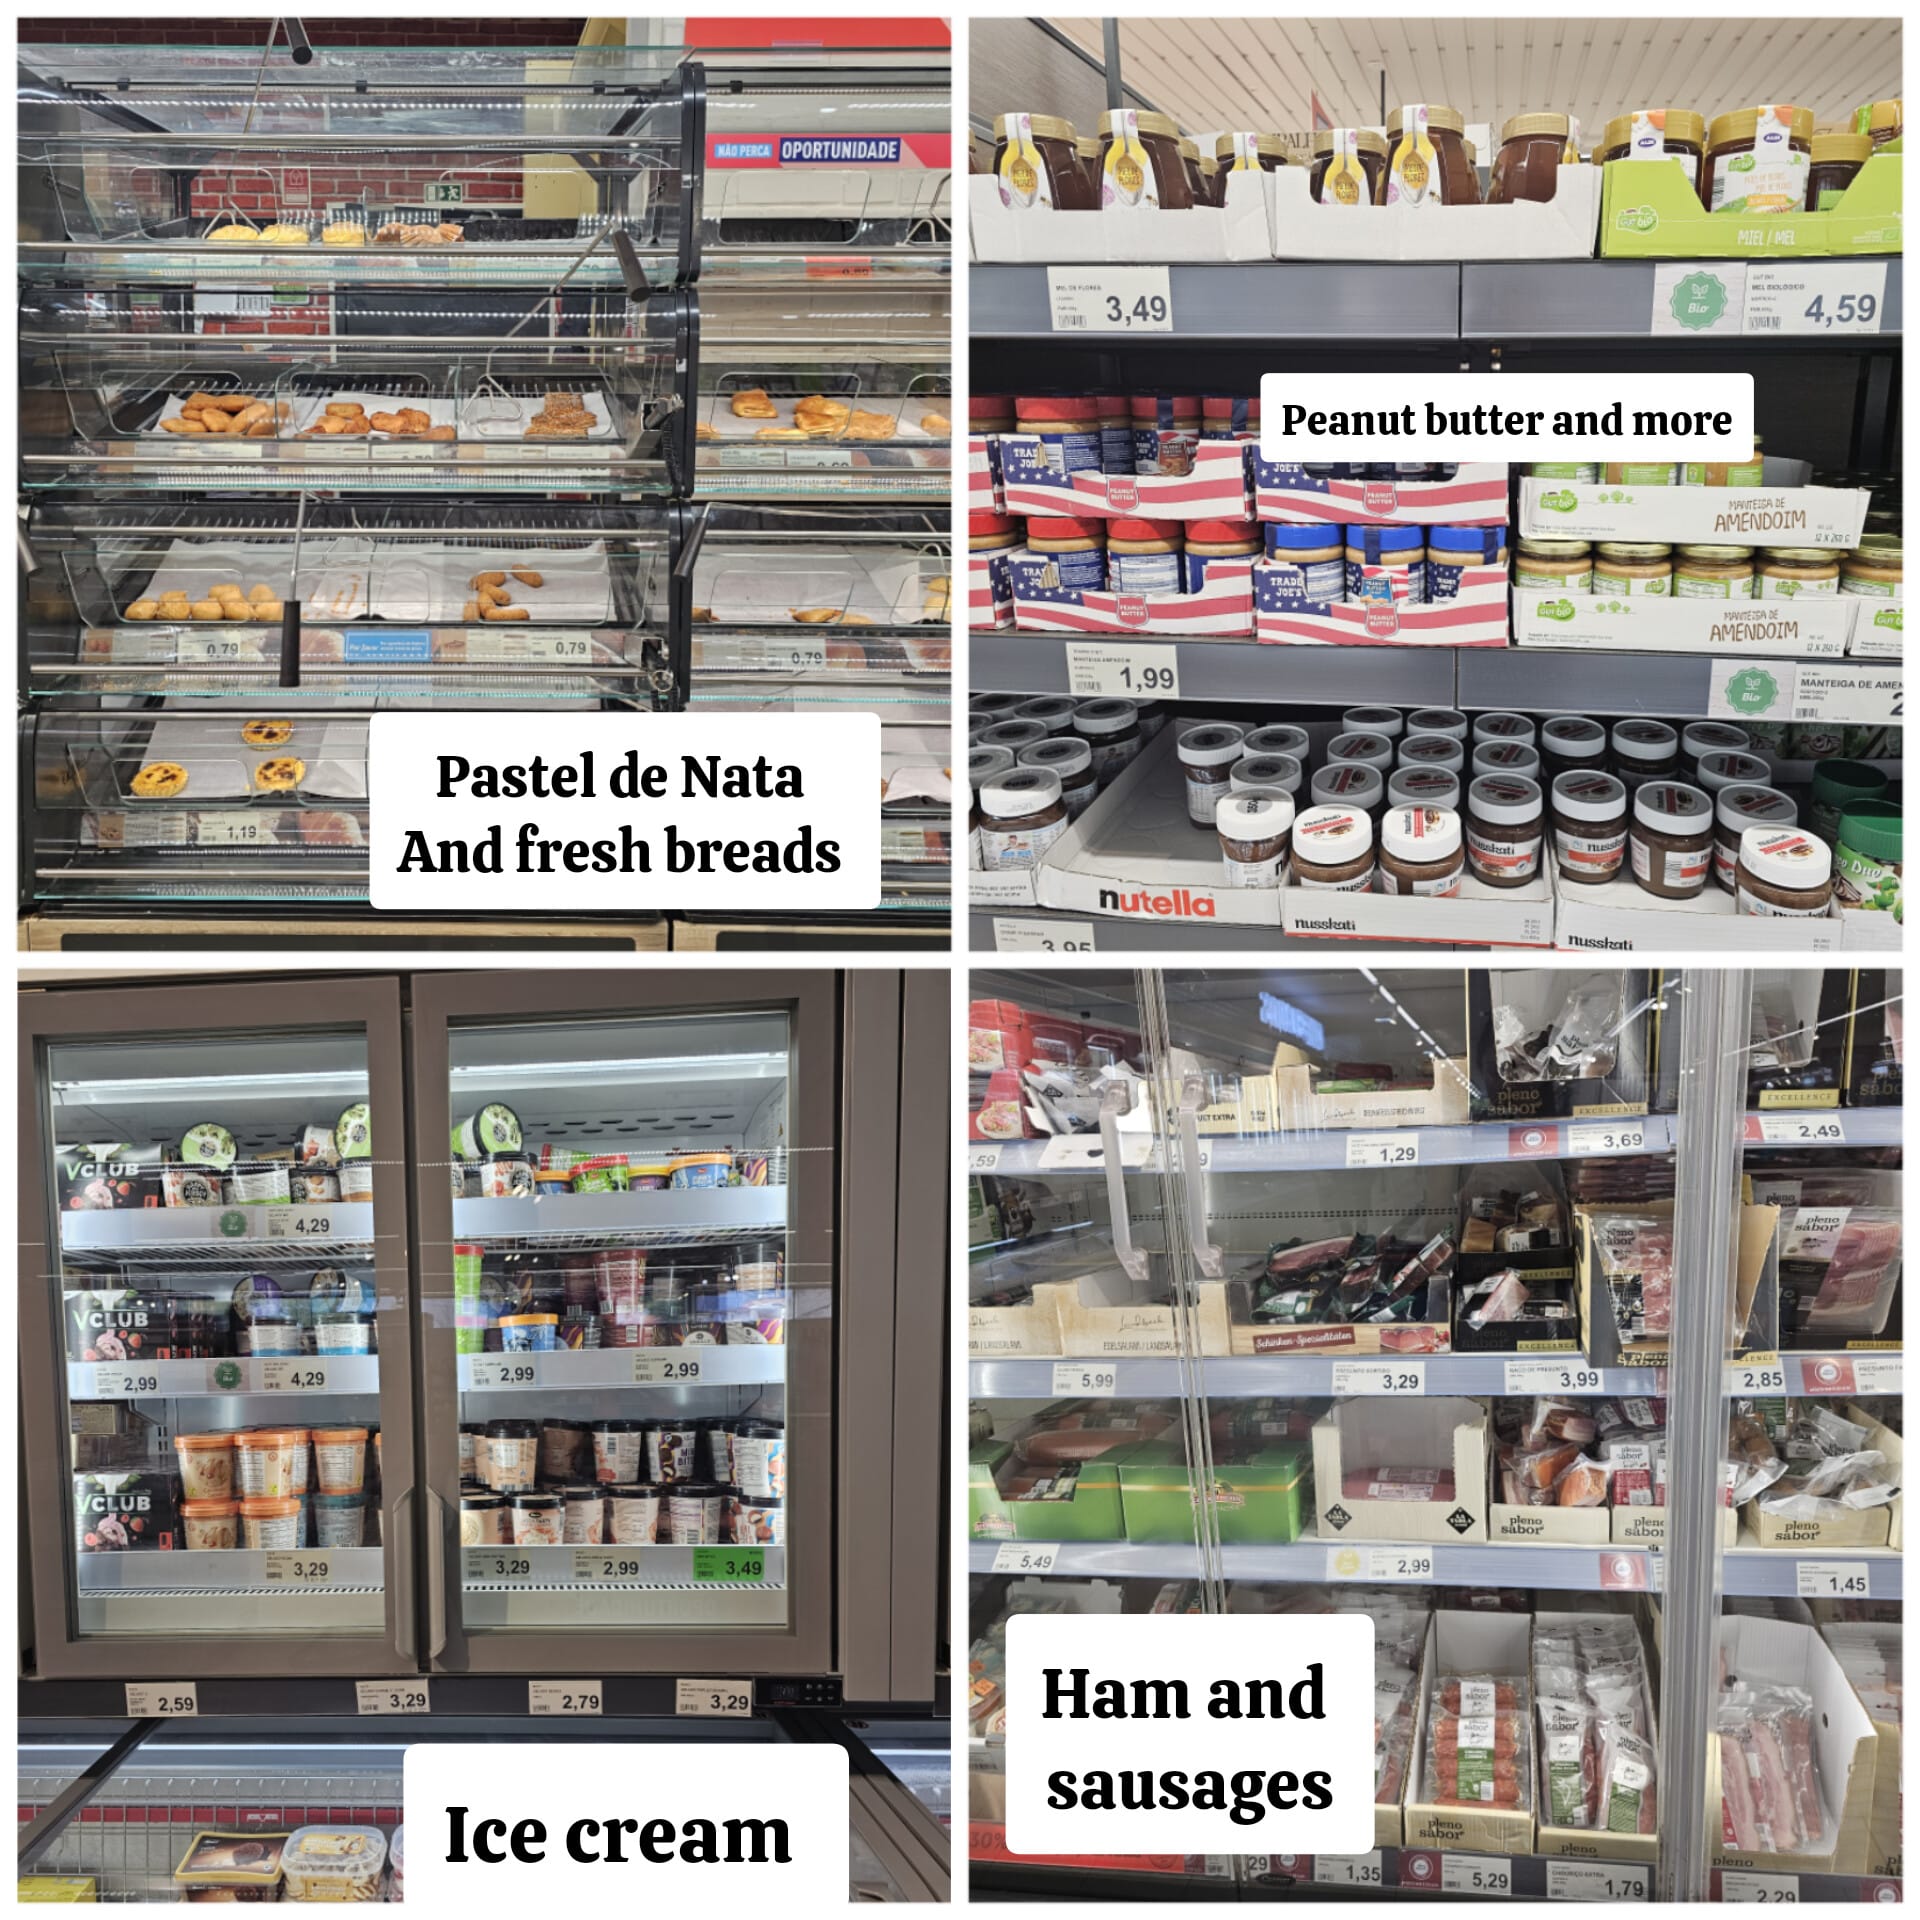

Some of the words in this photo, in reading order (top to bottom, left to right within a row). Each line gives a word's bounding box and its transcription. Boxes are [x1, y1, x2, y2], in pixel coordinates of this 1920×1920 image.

[718, 143, 737, 157] NÃO
[739, 144, 770, 156] PERCA
[782, 141, 897, 159] OPORTUNIDADE
[1738, 229, 1763, 246] MIEL
[1775, 229, 1796, 246] MEL
[1106, 295, 1167, 327] 3,49
[1687, 302, 1709, 314] Bio
[1804, 294, 1877, 328] 4,59
[1109, 487, 1135, 495] PEANUT
[1728, 500, 1773, 511] MANTEIGA
[1775, 497, 1786, 508] DE
[1714, 510, 1807, 533] AMENDOIM
[1275, 587, 1302, 597] JOE'S
[1723, 610, 1767, 621] MANTEIGA
[1768, 609, 1779, 619] DE
[1709, 621, 1799, 642] AMENDOIM
[207, 643, 239, 659] 0,79
[555, 641, 586, 656] 0,79
[791, 651, 823, 667] 0,79
[1120, 666, 1174, 693] 1,99
[1801, 678, 1856, 688] MANTEIGA
[1858, 679, 1873, 689] DE
[1741, 693, 1761, 702] Bio
[227, 825, 257, 841] 1,19
[1470, 835, 1515, 856] nusskati
[1851, 860, 1883, 879] Duo
[1099, 889, 1216, 917] nutella
[1294, 917, 1356, 931] nusskati
[1568, 934, 1633, 951] nusskati
[1768, 1093, 1832, 1102] EXCELLENCE
[1211, 1113, 1236, 1122] EXTRA
[1799, 1125, 1841, 1139] 2,49
[1603, 1133, 1643, 1150] 3,69
[969, 1154, 997, 1169] ,59
[1380, 1146, 1416, 1163] 1,29
[65, 1161, 139, 1181] VCLUB
[295, 1218, 330, 1237] 4,29
[1795, 1223, 1841, 1232] sabor
[1806, 1215, 1840, 1225] pleno
[72, 1309, 149, 1330] VCLUB
[500, 1366, 535, 1384] 2,99
[663, 1362, 700, 1380] 2,99
[124, 1376, 157, 1393] 2,99
[290, 1372, 325, 1389] 4,29
[1082, 1373, 1114, 1390] 5,99
[1383, 1374, 1419, 1390] 3,29
[1560, 1372, 1599, 1390] 3,99
[1744, 1372, 1783, 1389] 2,85
[77, 1495, 152, 1515] VCLUB
[1509, 1515, 1543, 1526] pleno
[1784, 1520, 1820, 1532] pleno
[1501, 1525, 1544, 1536] sabor
[1775, 1530, 1820, 1541] sabor
[293, 1561, 329, 1580] 3,29
[495, 1560, 530, 1577] 3,29
[603, 1561, 639, 1578] 2,99
[725, 1560, 762, 1578] 3,49
[1020, 1555, 1053, 1569] 5,49
[1397, 1559, 1431, 1575] 2,99
[1829, 1577, 1866, 1593] 1,45
[158, 1697, 195, 1714] 2,59
[389, 1693, 427, 1711] 3,29
[562, 1694, 599, 1711] 2,79
[710, 1694, 749, 1711] 3,29
[1428, 1817, 1463, 1831] pleno
[1419, 1827, 1464, 1841] sabor
[1561, 1842, 1598, 1854] pleno
[1712, 1856, 1754, 1868] pleno
[1345, 1865, 1382, 1883] 1,35
[1472, 1871, 1508, 1890] 5,29
[1603, 1879, 1644, 1898] 1,79
